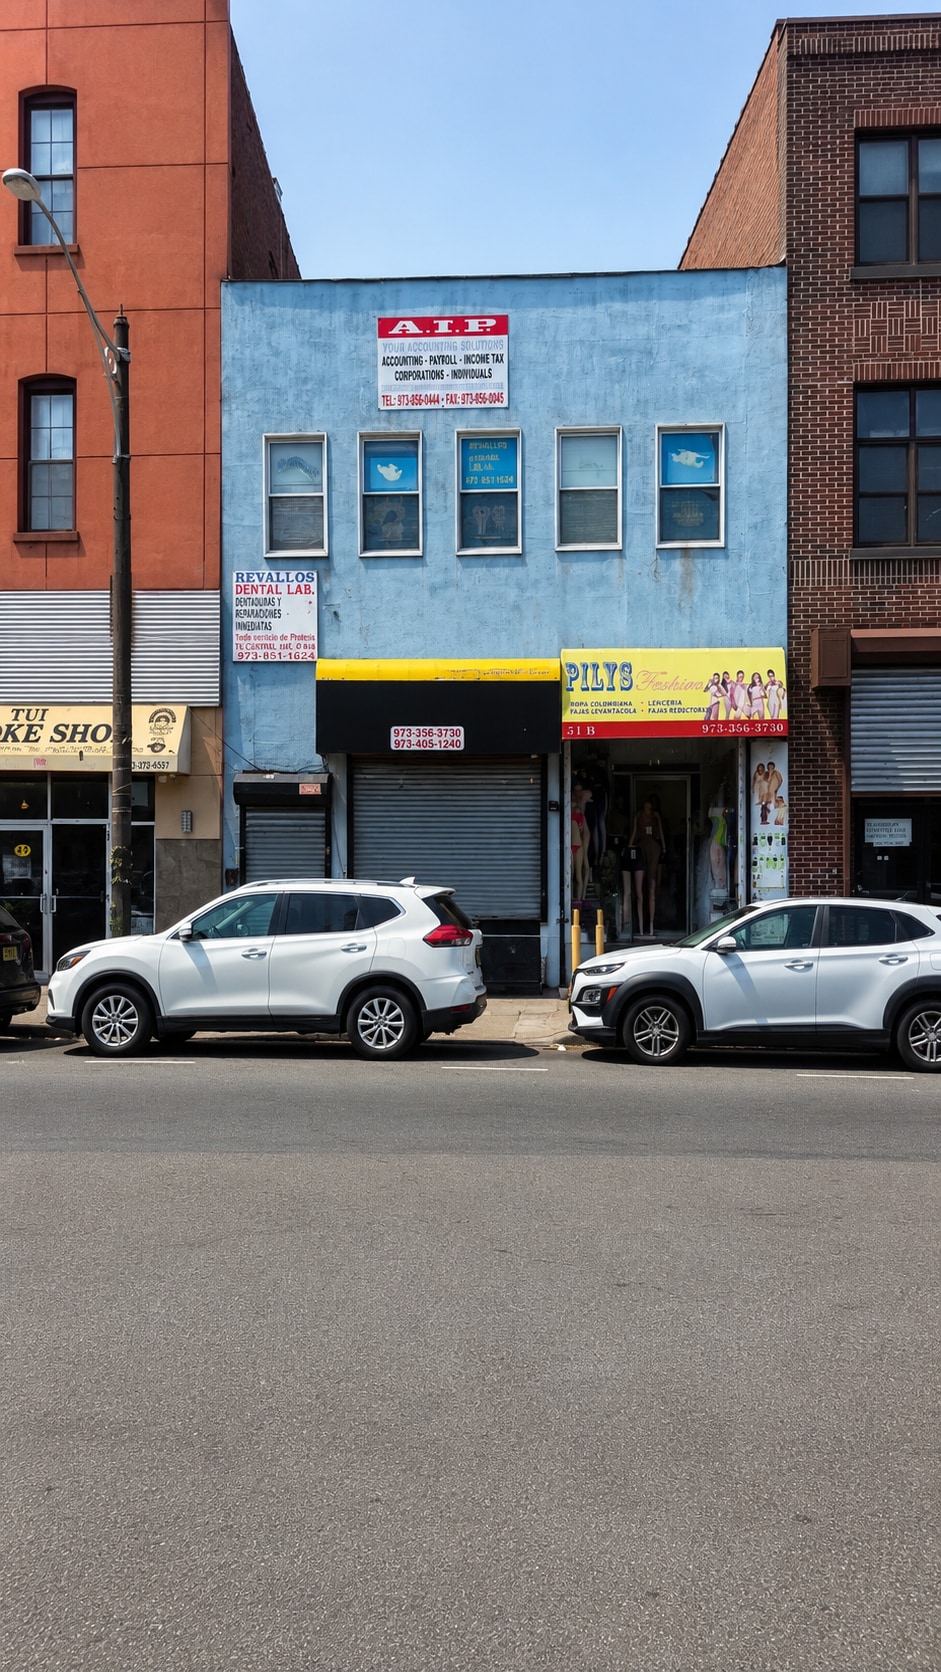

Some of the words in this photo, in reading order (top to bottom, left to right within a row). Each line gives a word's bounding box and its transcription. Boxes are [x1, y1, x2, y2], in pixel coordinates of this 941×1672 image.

[382, 342, 405, 353] YOUR
[407, 341, 458, 352] ACCOUNTING
[461, 339, 504, 351] SOLUTIONS
[382, 355, 424, 367] ACCOUNTING
[429, 354, 458, 365] PAYROLL
[463, 353, 490, 364] INCOME
[491, 353, 504, 364] TAX
[394, 369, 445, 381] CORPORATIONS
[451, 368, 493, 379] INDIVIDUALS
[235, 572, 315, 583] REVALLOS
[235, 584, 282, 595] DENTAL
[287, 584, 315, 595] LAB.
[277, 597, 282, 607] Y
[280, 633, 288, 642] de
[237, 651, 315, 660] 973-851-1624
[564, 661, 634, 692] PILYS
[11, 708, 49, 722] TUI
[49, 723, 113, 743] SHO
[393, 728, 461, 738] 973-356-3730
[567, 726, 581, 736] 51
[587, 726, 595, 736] B
[702, 722, 784, 734] 973-356-3730
[394, 739, 461, 749] 973-405-1240
